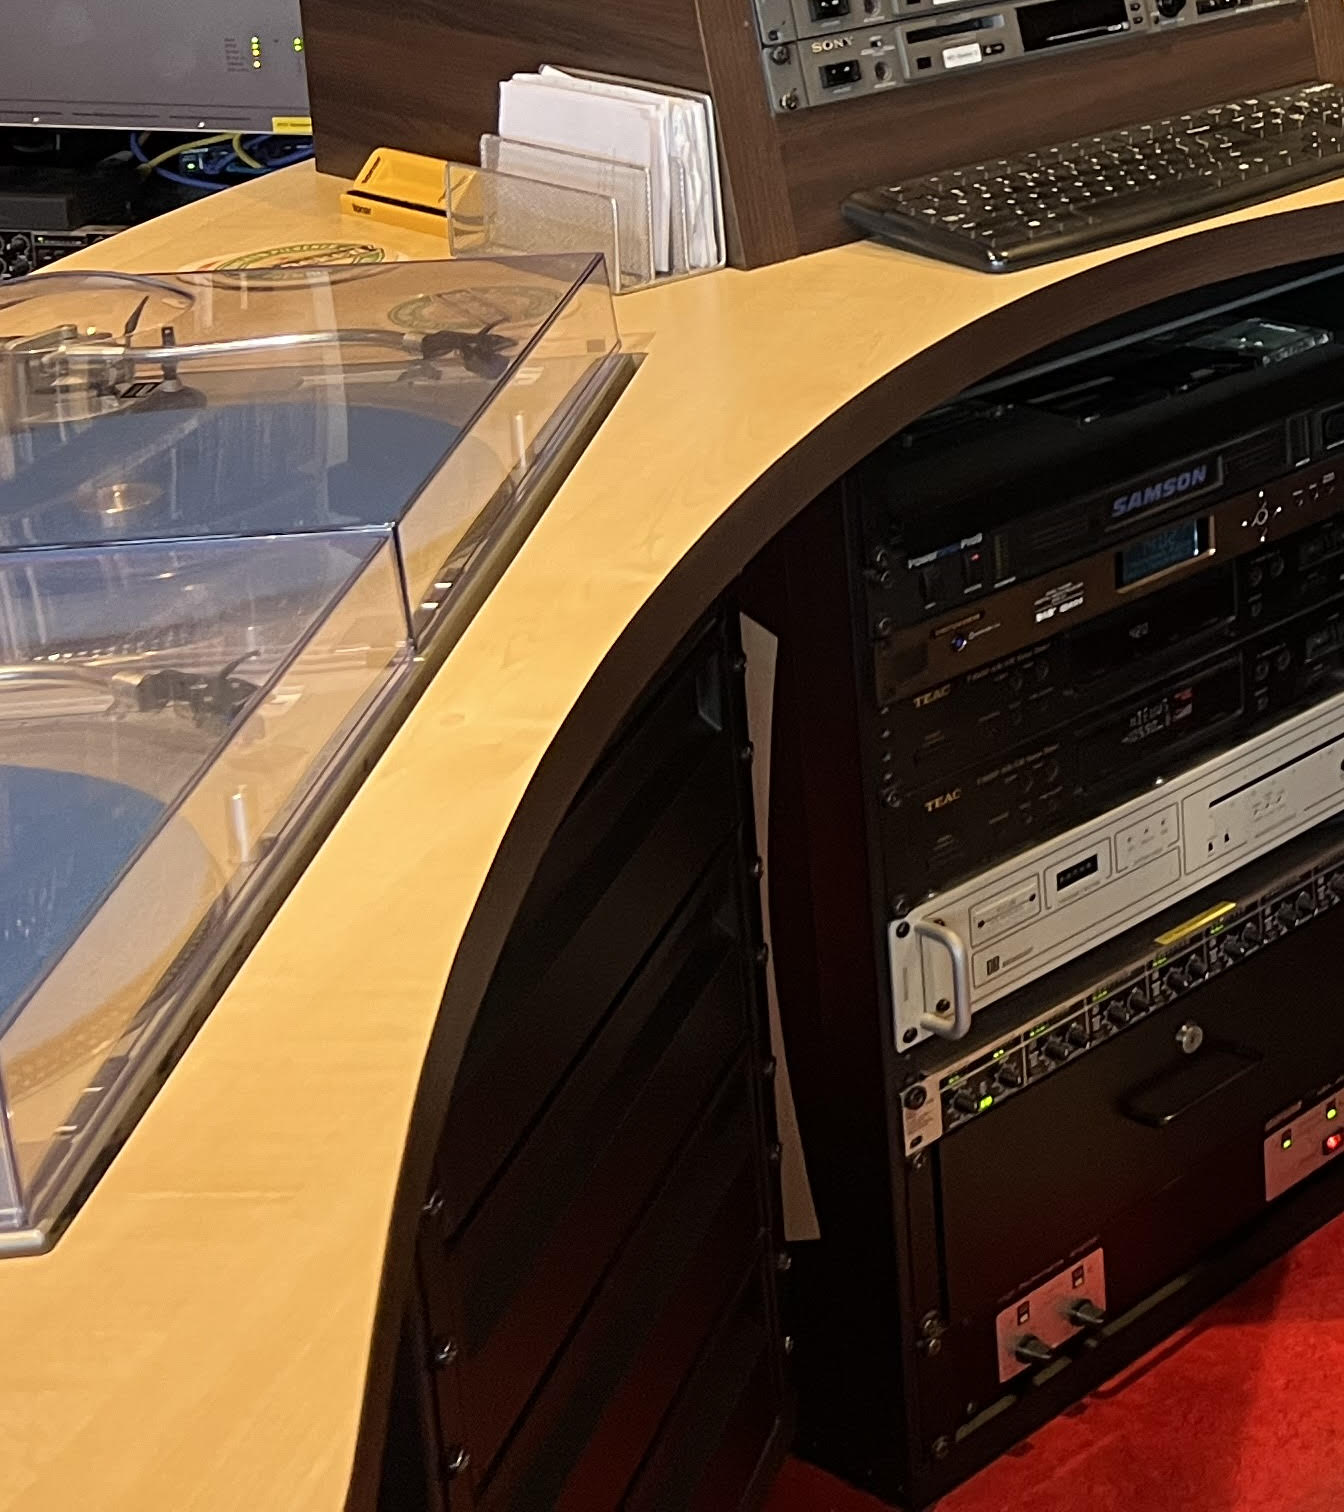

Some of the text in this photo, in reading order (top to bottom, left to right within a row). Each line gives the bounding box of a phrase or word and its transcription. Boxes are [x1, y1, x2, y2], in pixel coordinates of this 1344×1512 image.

[811, 36, 853, 55] SONY
[1111, 464, 1207, 518] SAMSON
[913, 683, 951, 709] TEAC
[925, 788, 962, 812] TEAC
